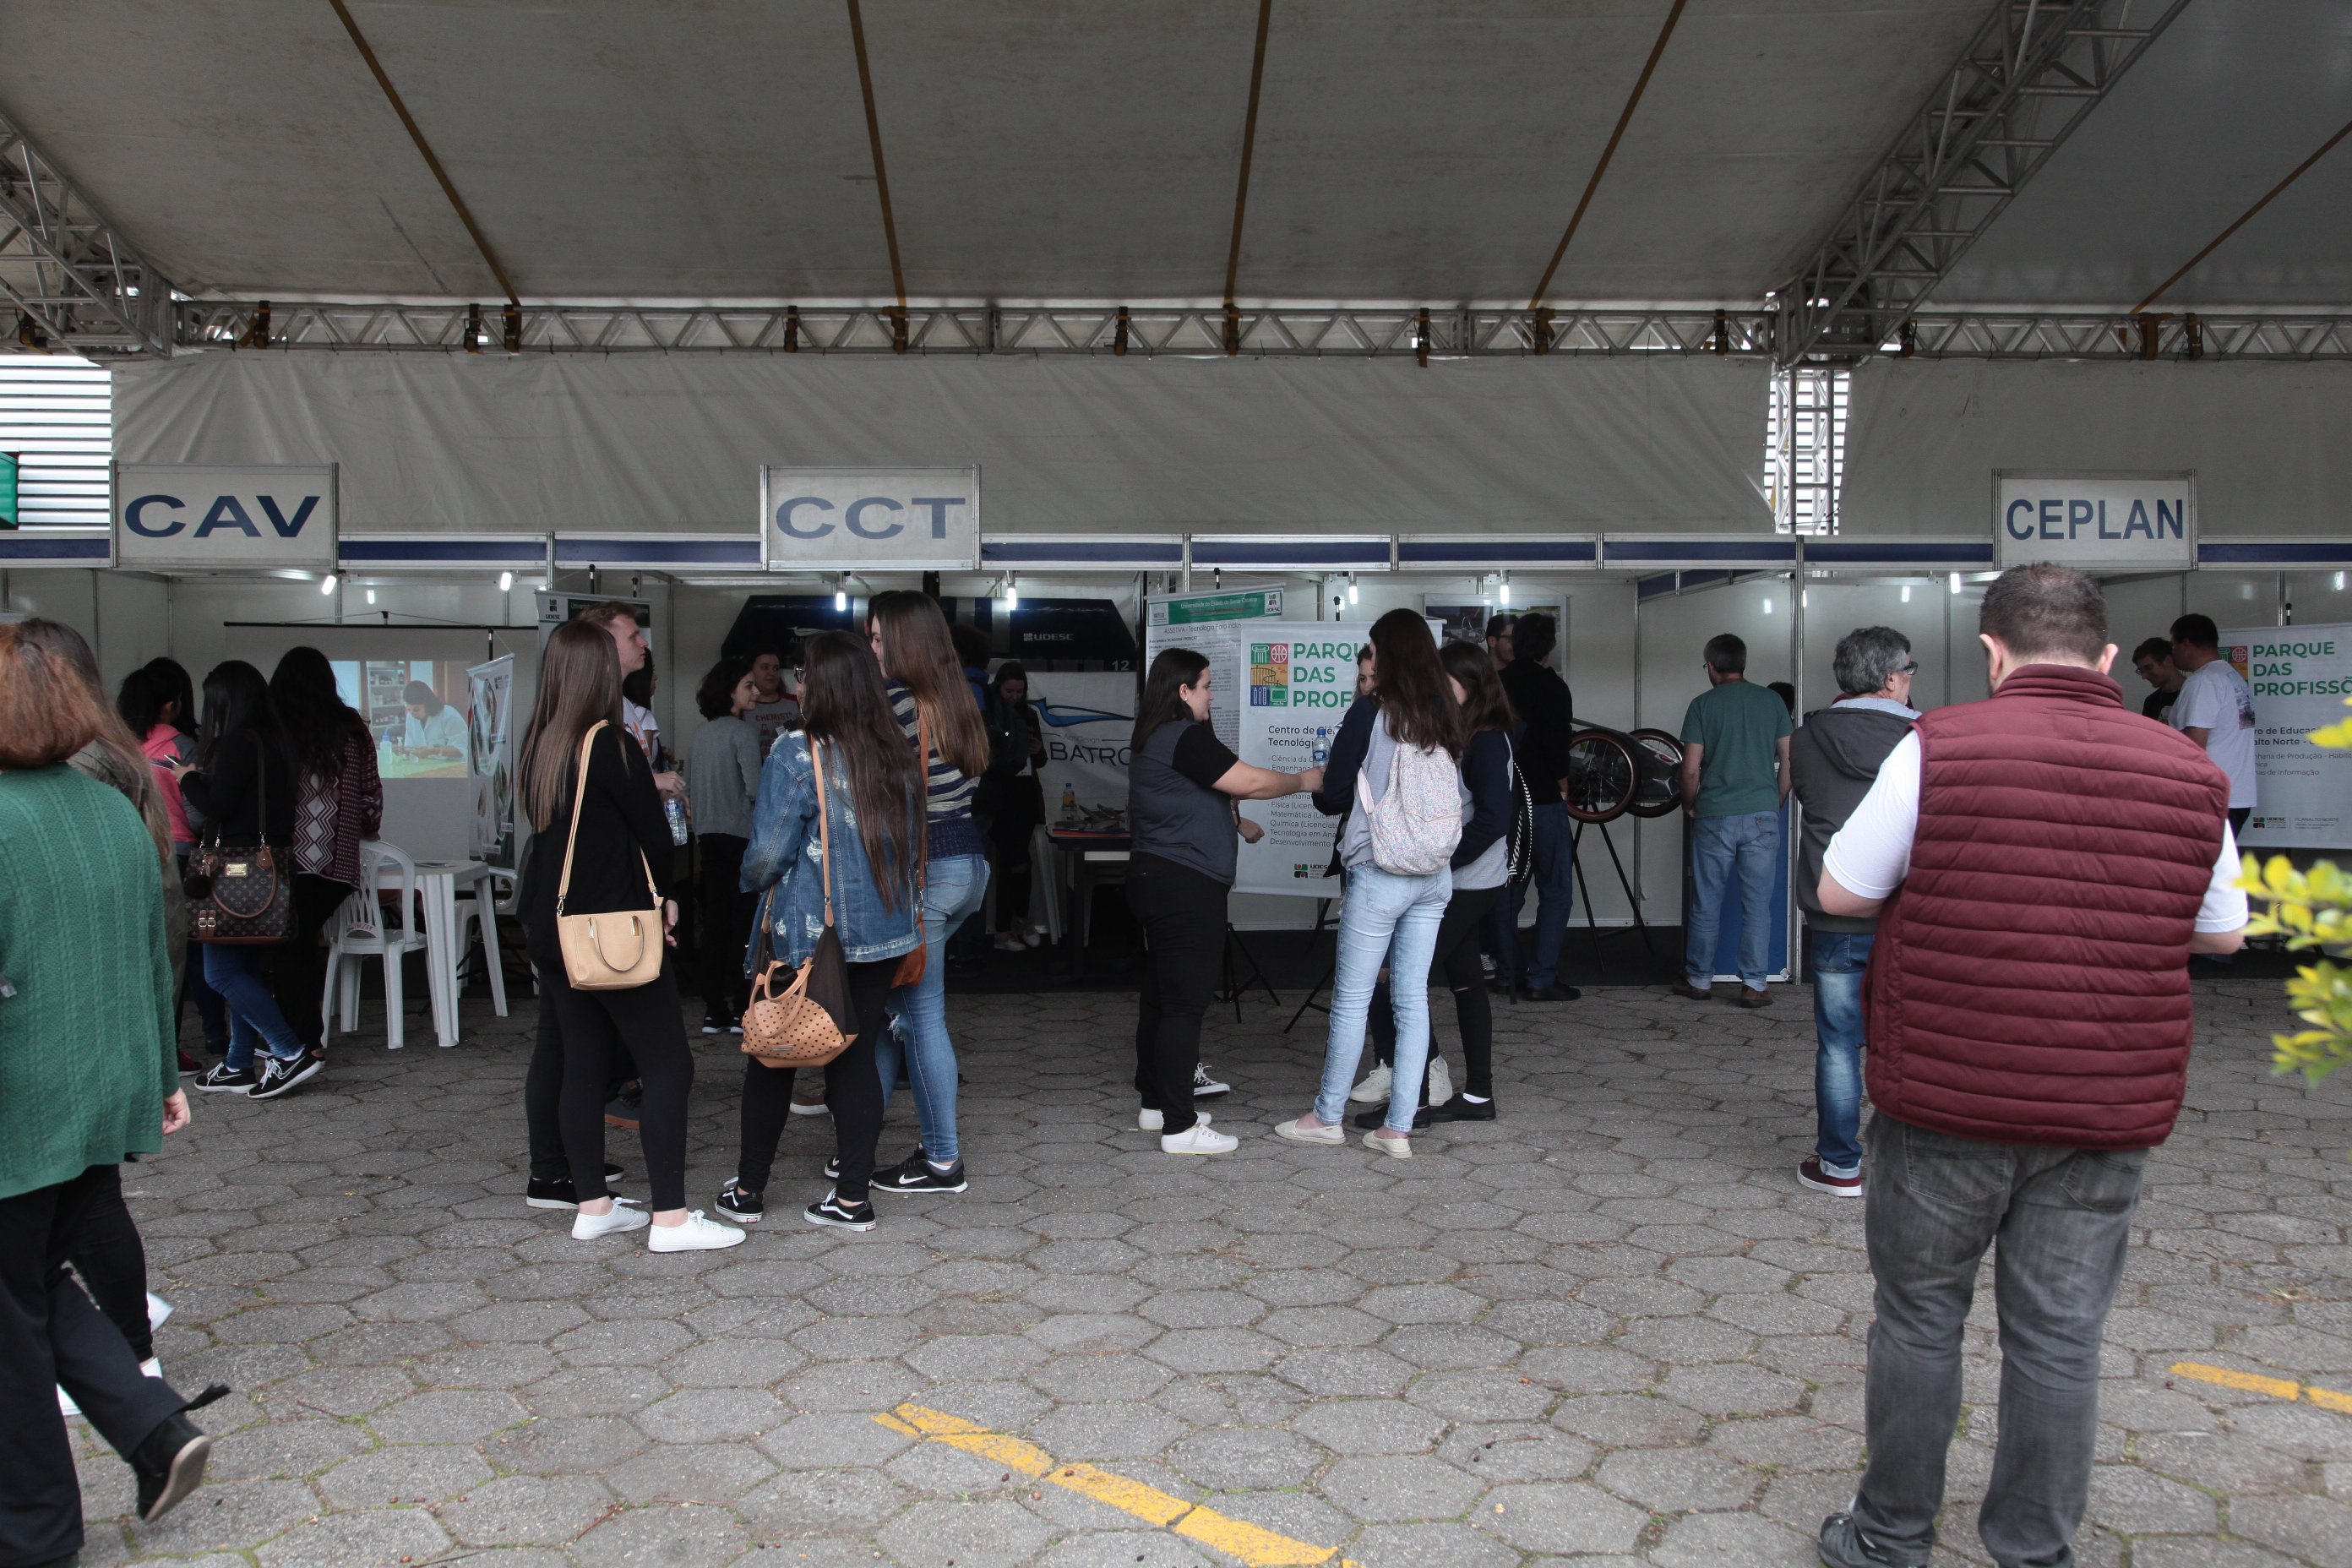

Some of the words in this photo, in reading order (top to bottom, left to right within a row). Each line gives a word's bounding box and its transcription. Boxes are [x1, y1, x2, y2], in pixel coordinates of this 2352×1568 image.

[125, 494, 321, 538] CAV
[776, 496, 966, 540] CCT
[2006, 498, 2184, 541] CEPLAN
[1189, 624, 1215, 633] Tecnologia
[1033, 633, 1075, 641] UDESC
[1293, 642, 1371, 662] PARQU
[2253, 641, 2335, 659] PARQUE
[1112, 660, 1130, 671] 12
[2253, 662, 2293, 677] DAS
[1293, 667, 1336, 683] DAS
[2254, 676, 2352, 697] PROFISSÕ
[1293, 690, 1353, 708] PROF
[755, 712, 792, 721] CHEMIST
[1268, 726, 1300, 734] Centro
[1302, 726, 1315, 735] de
[1268, 738, 1314, 749] Tecnológi
[1047, 742, 1131, 766] BATRO
[1271, 810, 1312, 819] Matemática
[1270, 829, 1308, 838] Tecnologia
[1270, 838, 1331, 847] Desenvolvimento
